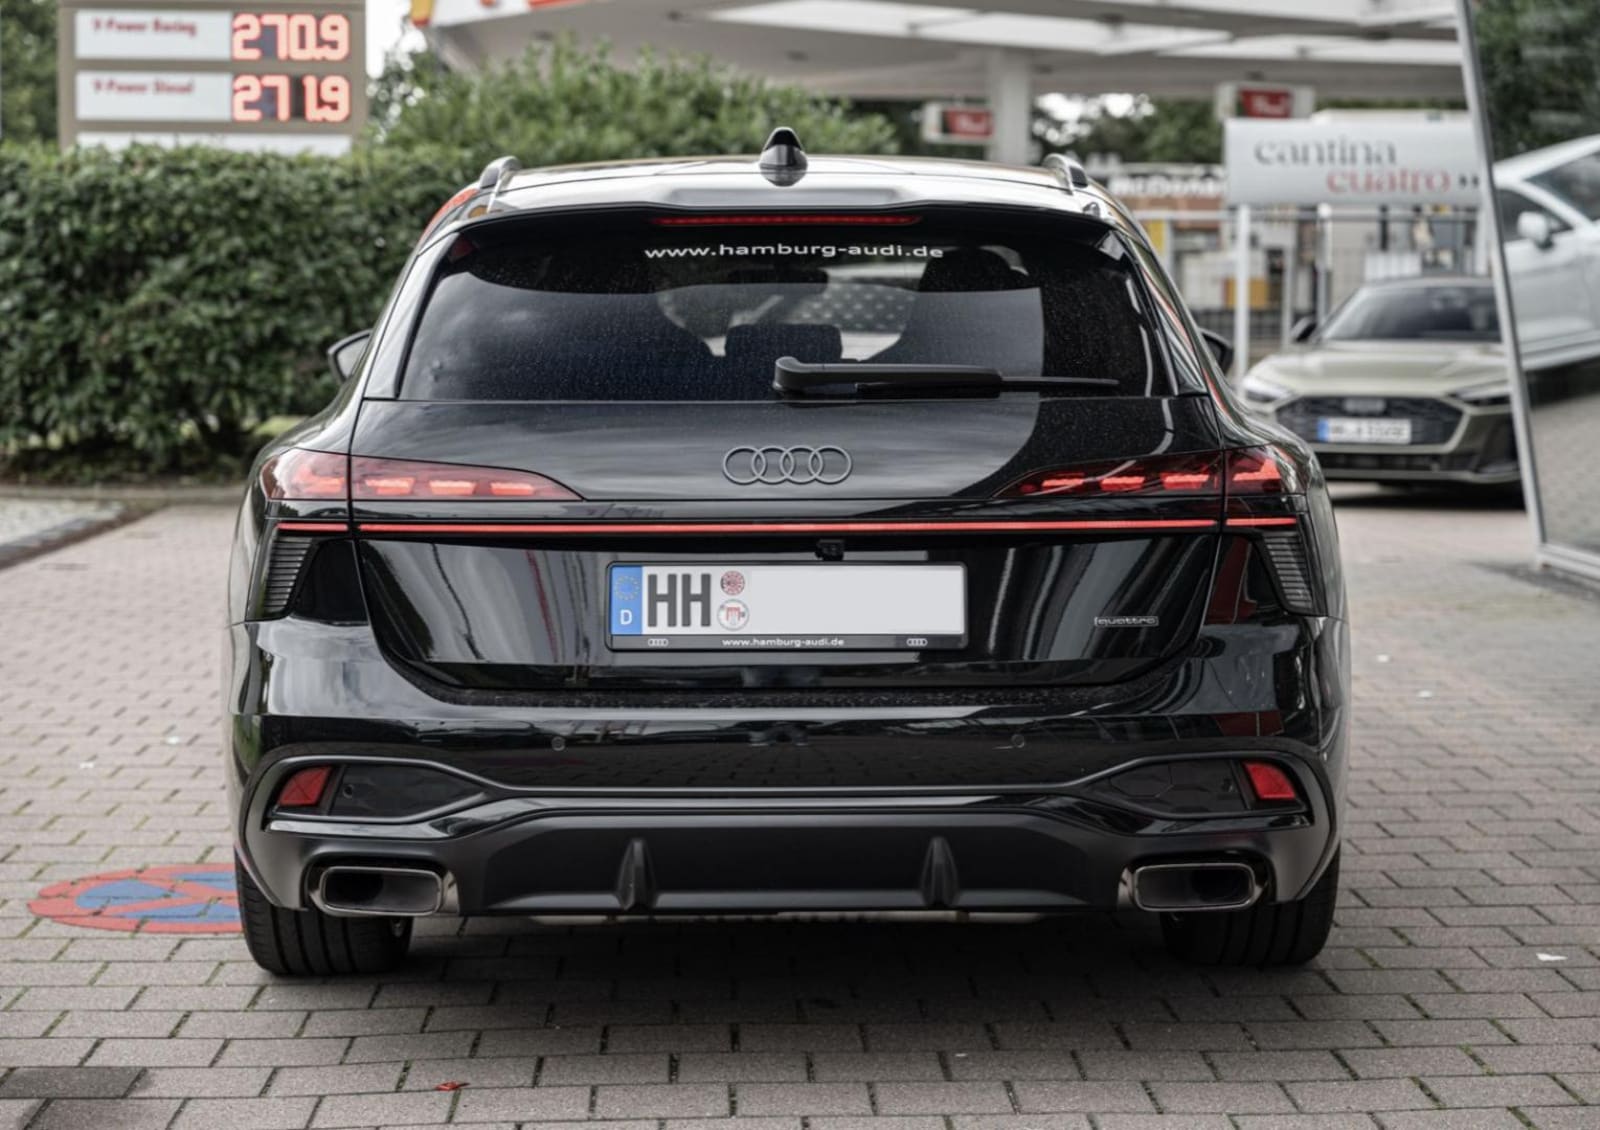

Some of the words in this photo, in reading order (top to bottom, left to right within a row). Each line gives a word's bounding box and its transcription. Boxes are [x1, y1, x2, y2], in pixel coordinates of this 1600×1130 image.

[1254, 135, 1396, 166] cantina
[1326, 168, 1450, 194] cuatro
[644, 243, 944, 259] www.hamburg-audi.de
[647, 573, 712, 628] HH
[619, 609, 633, 625] D
[1097, 616, 1156, 627] quattro
[721, 637, 845, 649] www.hamburg-audi.de
